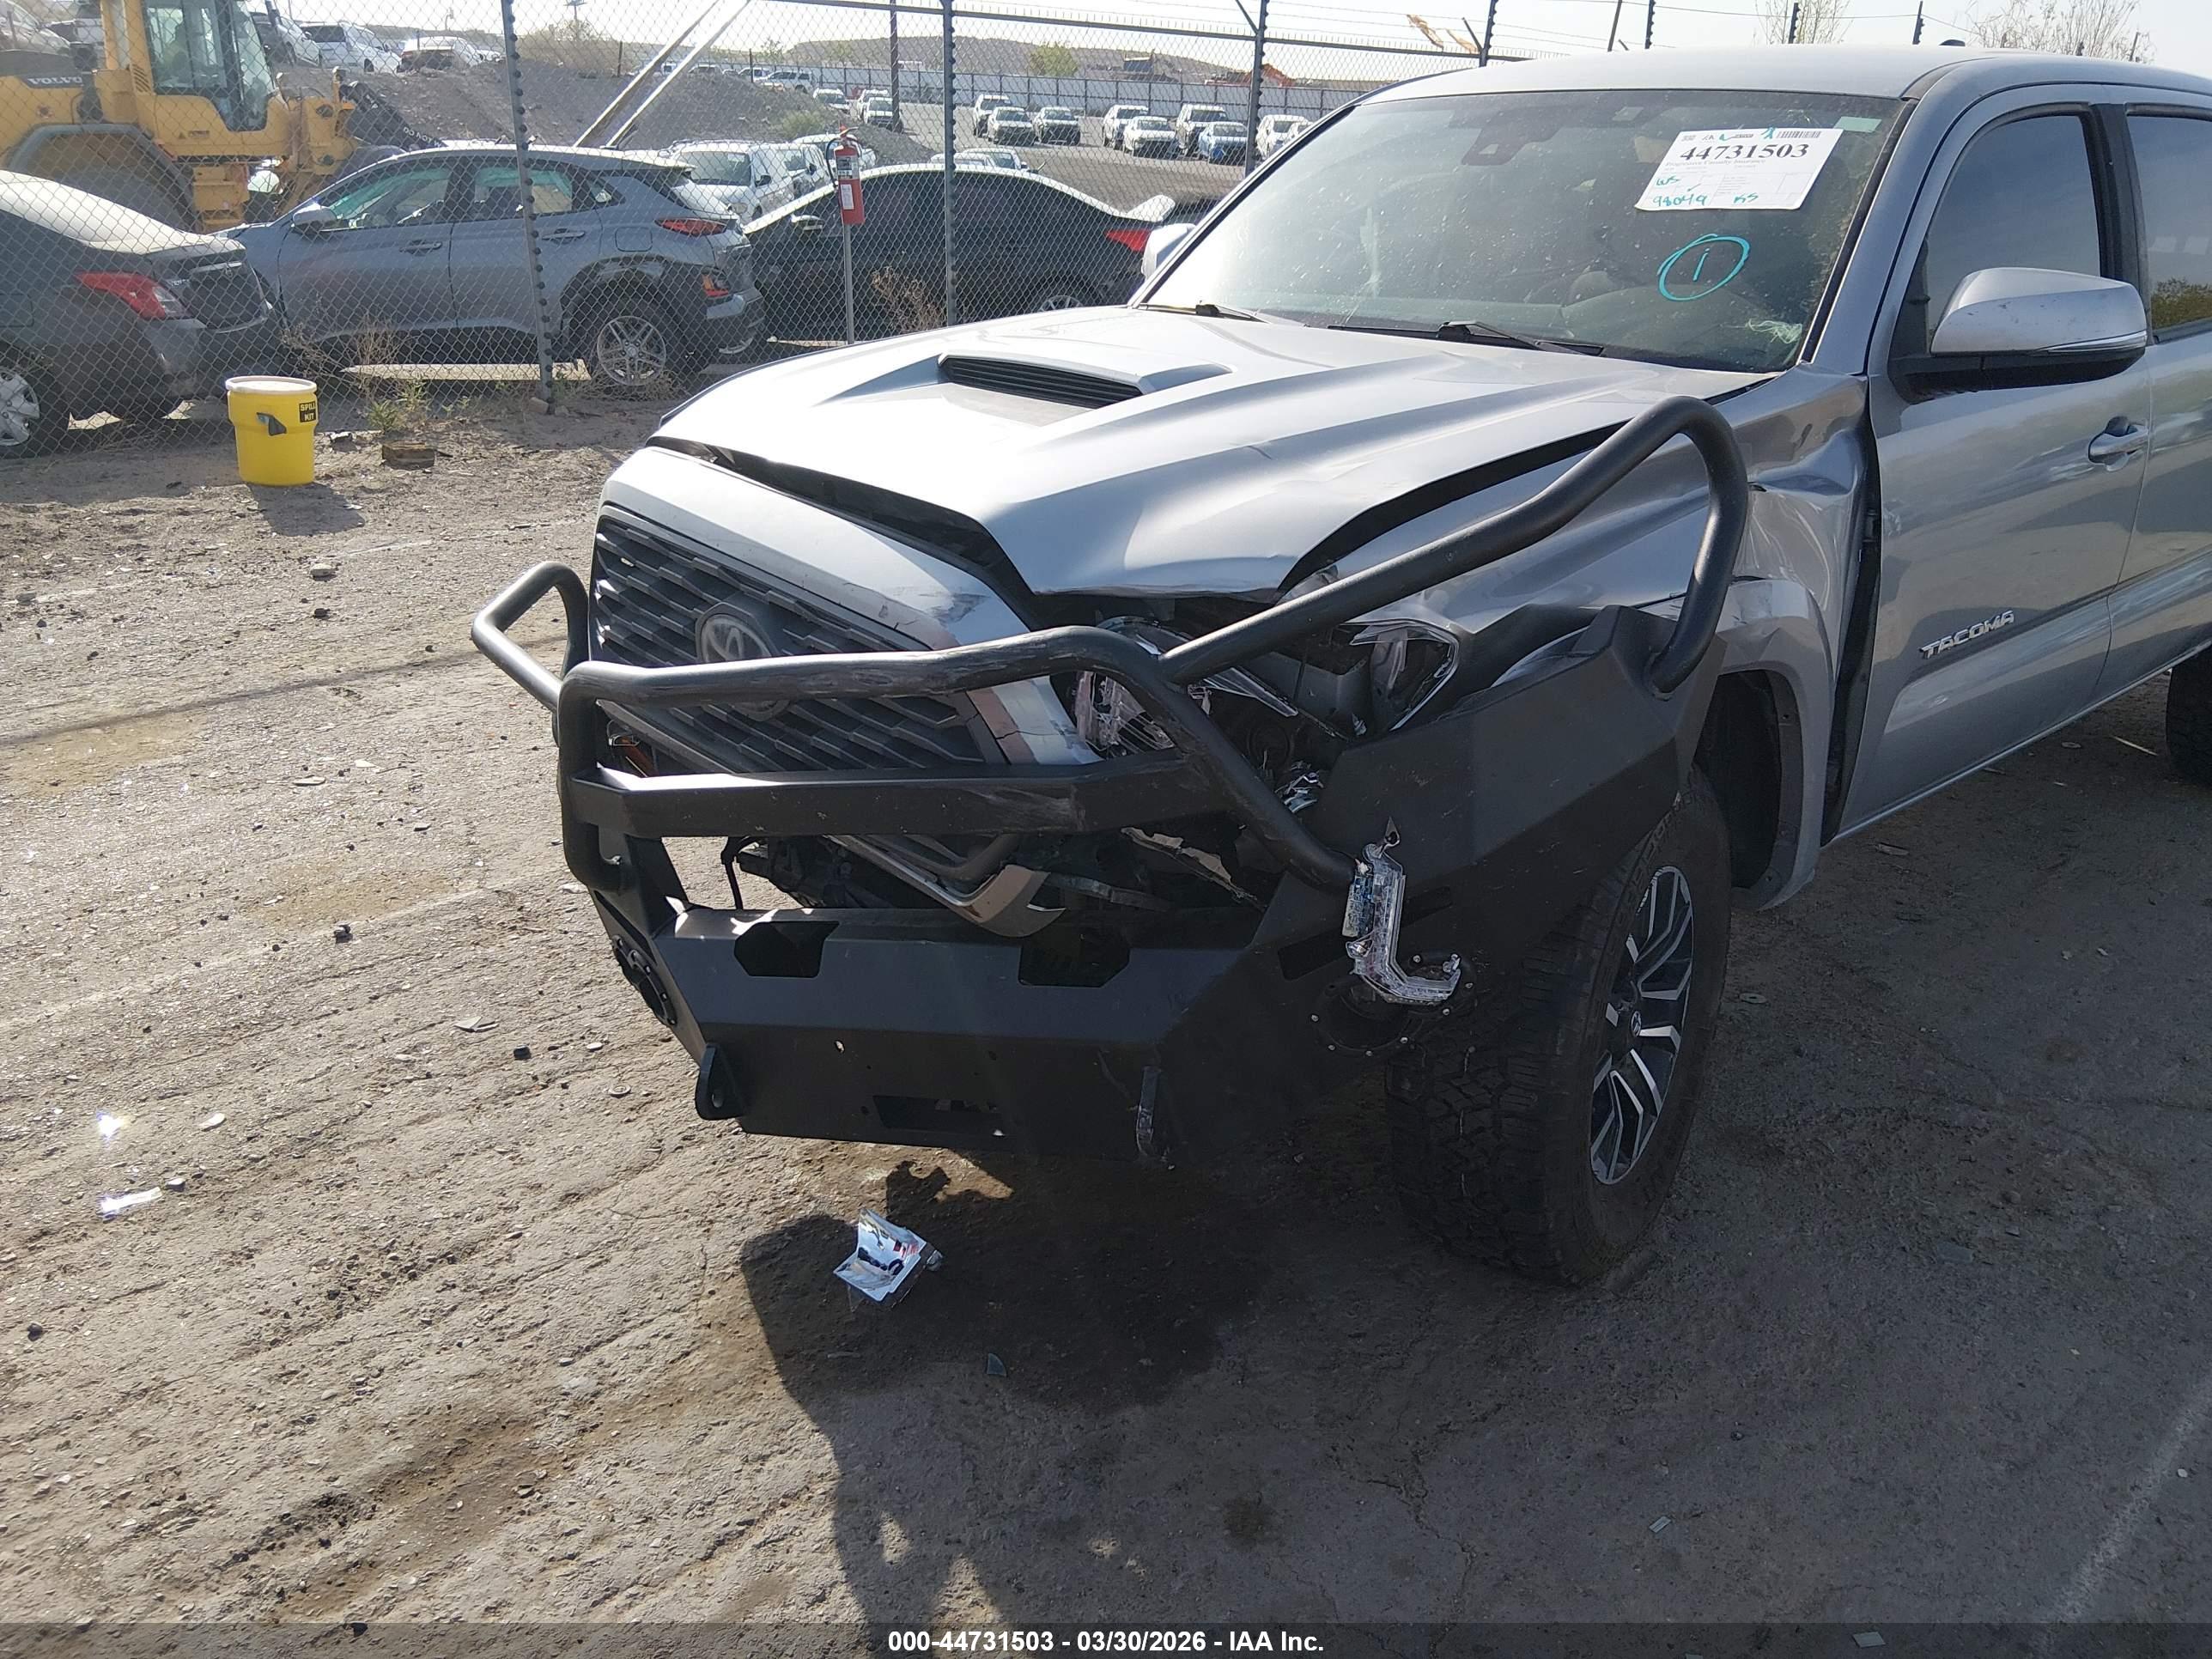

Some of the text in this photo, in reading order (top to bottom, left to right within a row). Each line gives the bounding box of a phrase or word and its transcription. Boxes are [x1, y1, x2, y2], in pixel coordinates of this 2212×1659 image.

[1680, 143, 1809, 161] 44731503
[304, 412, 314, 421] KIT
[1920, 610, 2014, 659] TACOMA
